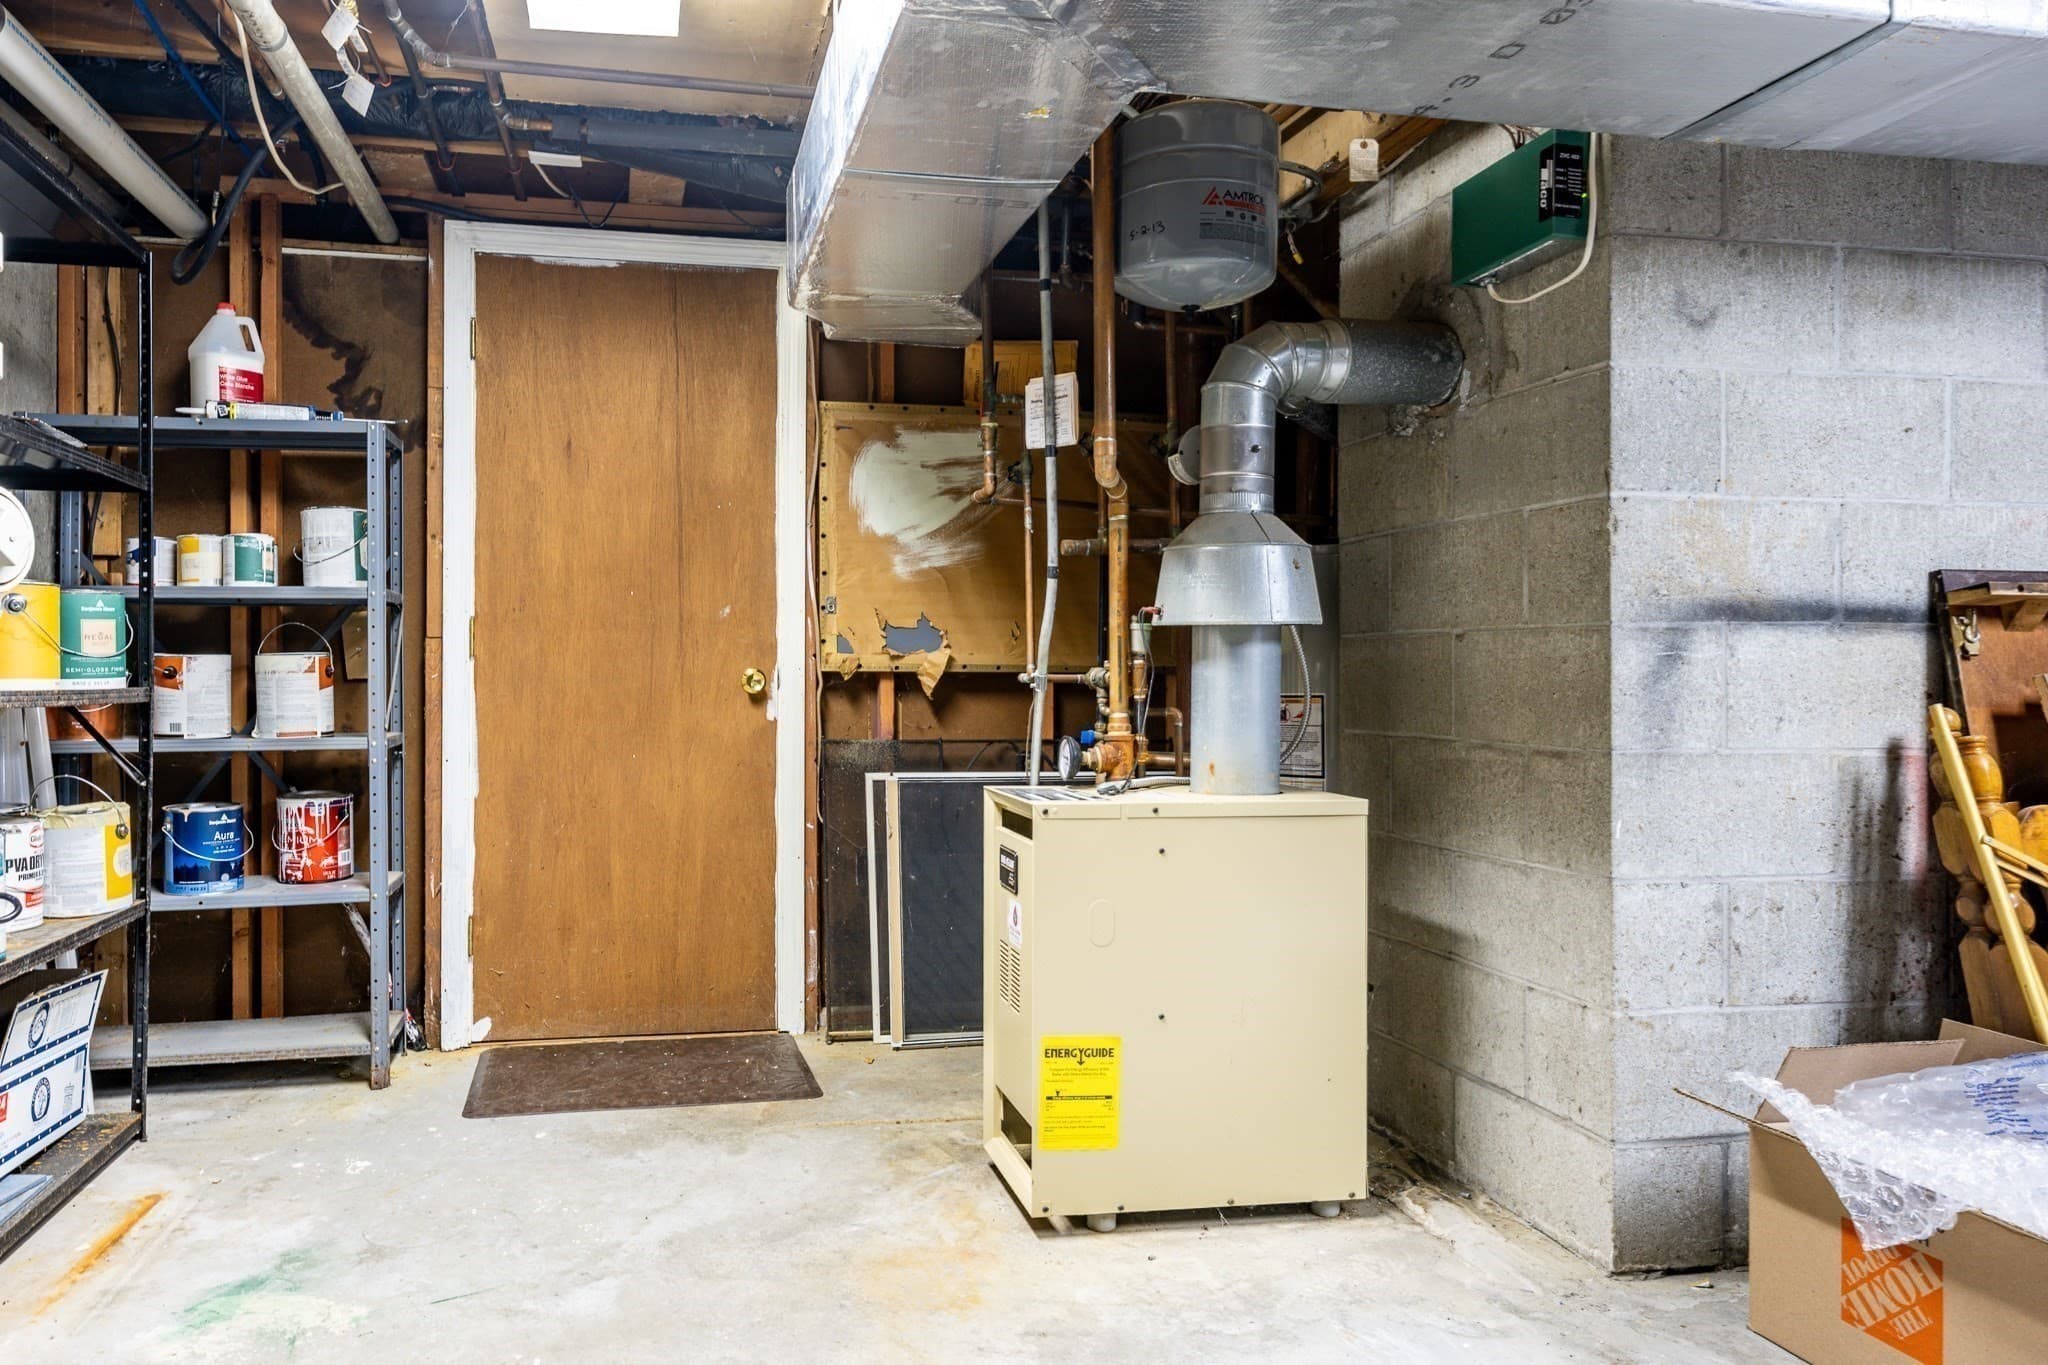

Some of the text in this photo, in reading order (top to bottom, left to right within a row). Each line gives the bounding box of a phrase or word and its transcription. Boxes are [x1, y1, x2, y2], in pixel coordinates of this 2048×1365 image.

[1222, 189, 1265, 205] AMTROL
[214, 831, 235, 841] Aura
[5, 857, 28, 874] PVA
[1841, 1252, 1942, 1328] HOME
[1888, 1306, 1934, 1339] THE
